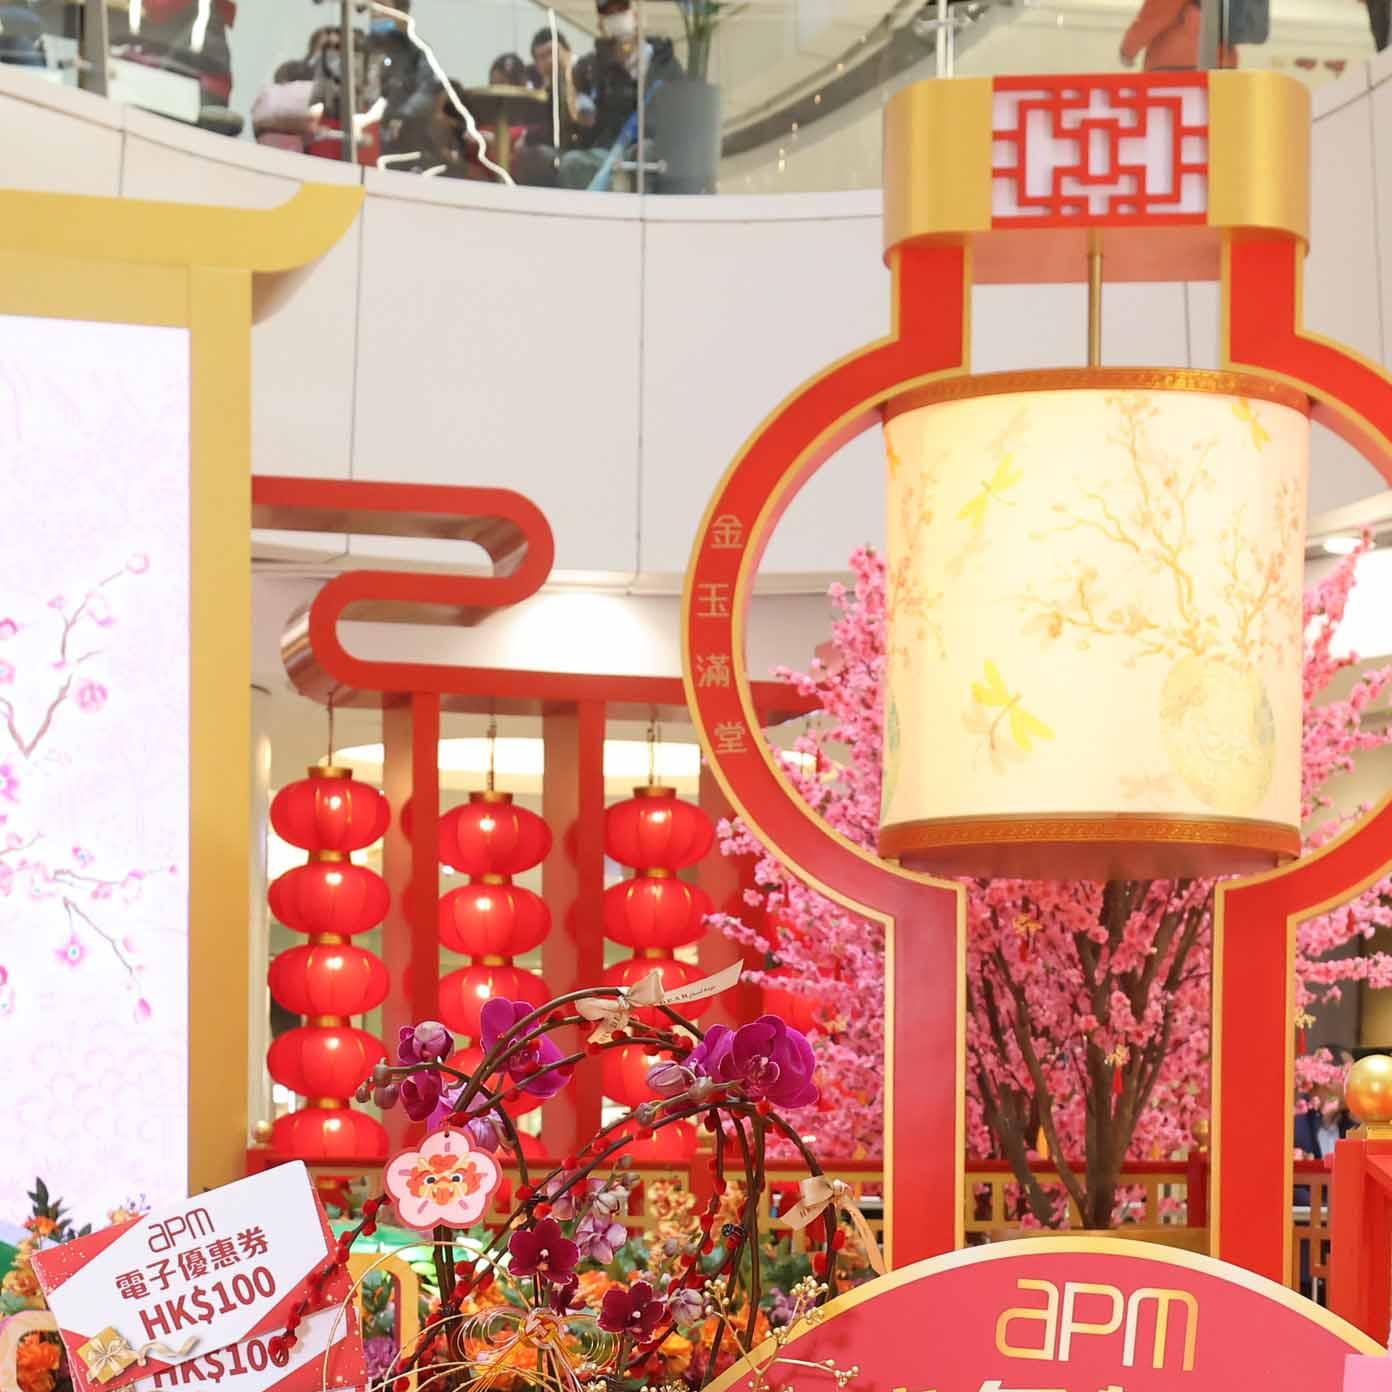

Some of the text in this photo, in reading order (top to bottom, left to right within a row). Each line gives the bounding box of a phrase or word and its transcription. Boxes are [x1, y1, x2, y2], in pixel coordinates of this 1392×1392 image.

[697, 514, 747, 754] 金玉滿堂
[115, 1226, 269, 1301] 電子優惠券
[138, 1266, 276, 1341] HK$100
